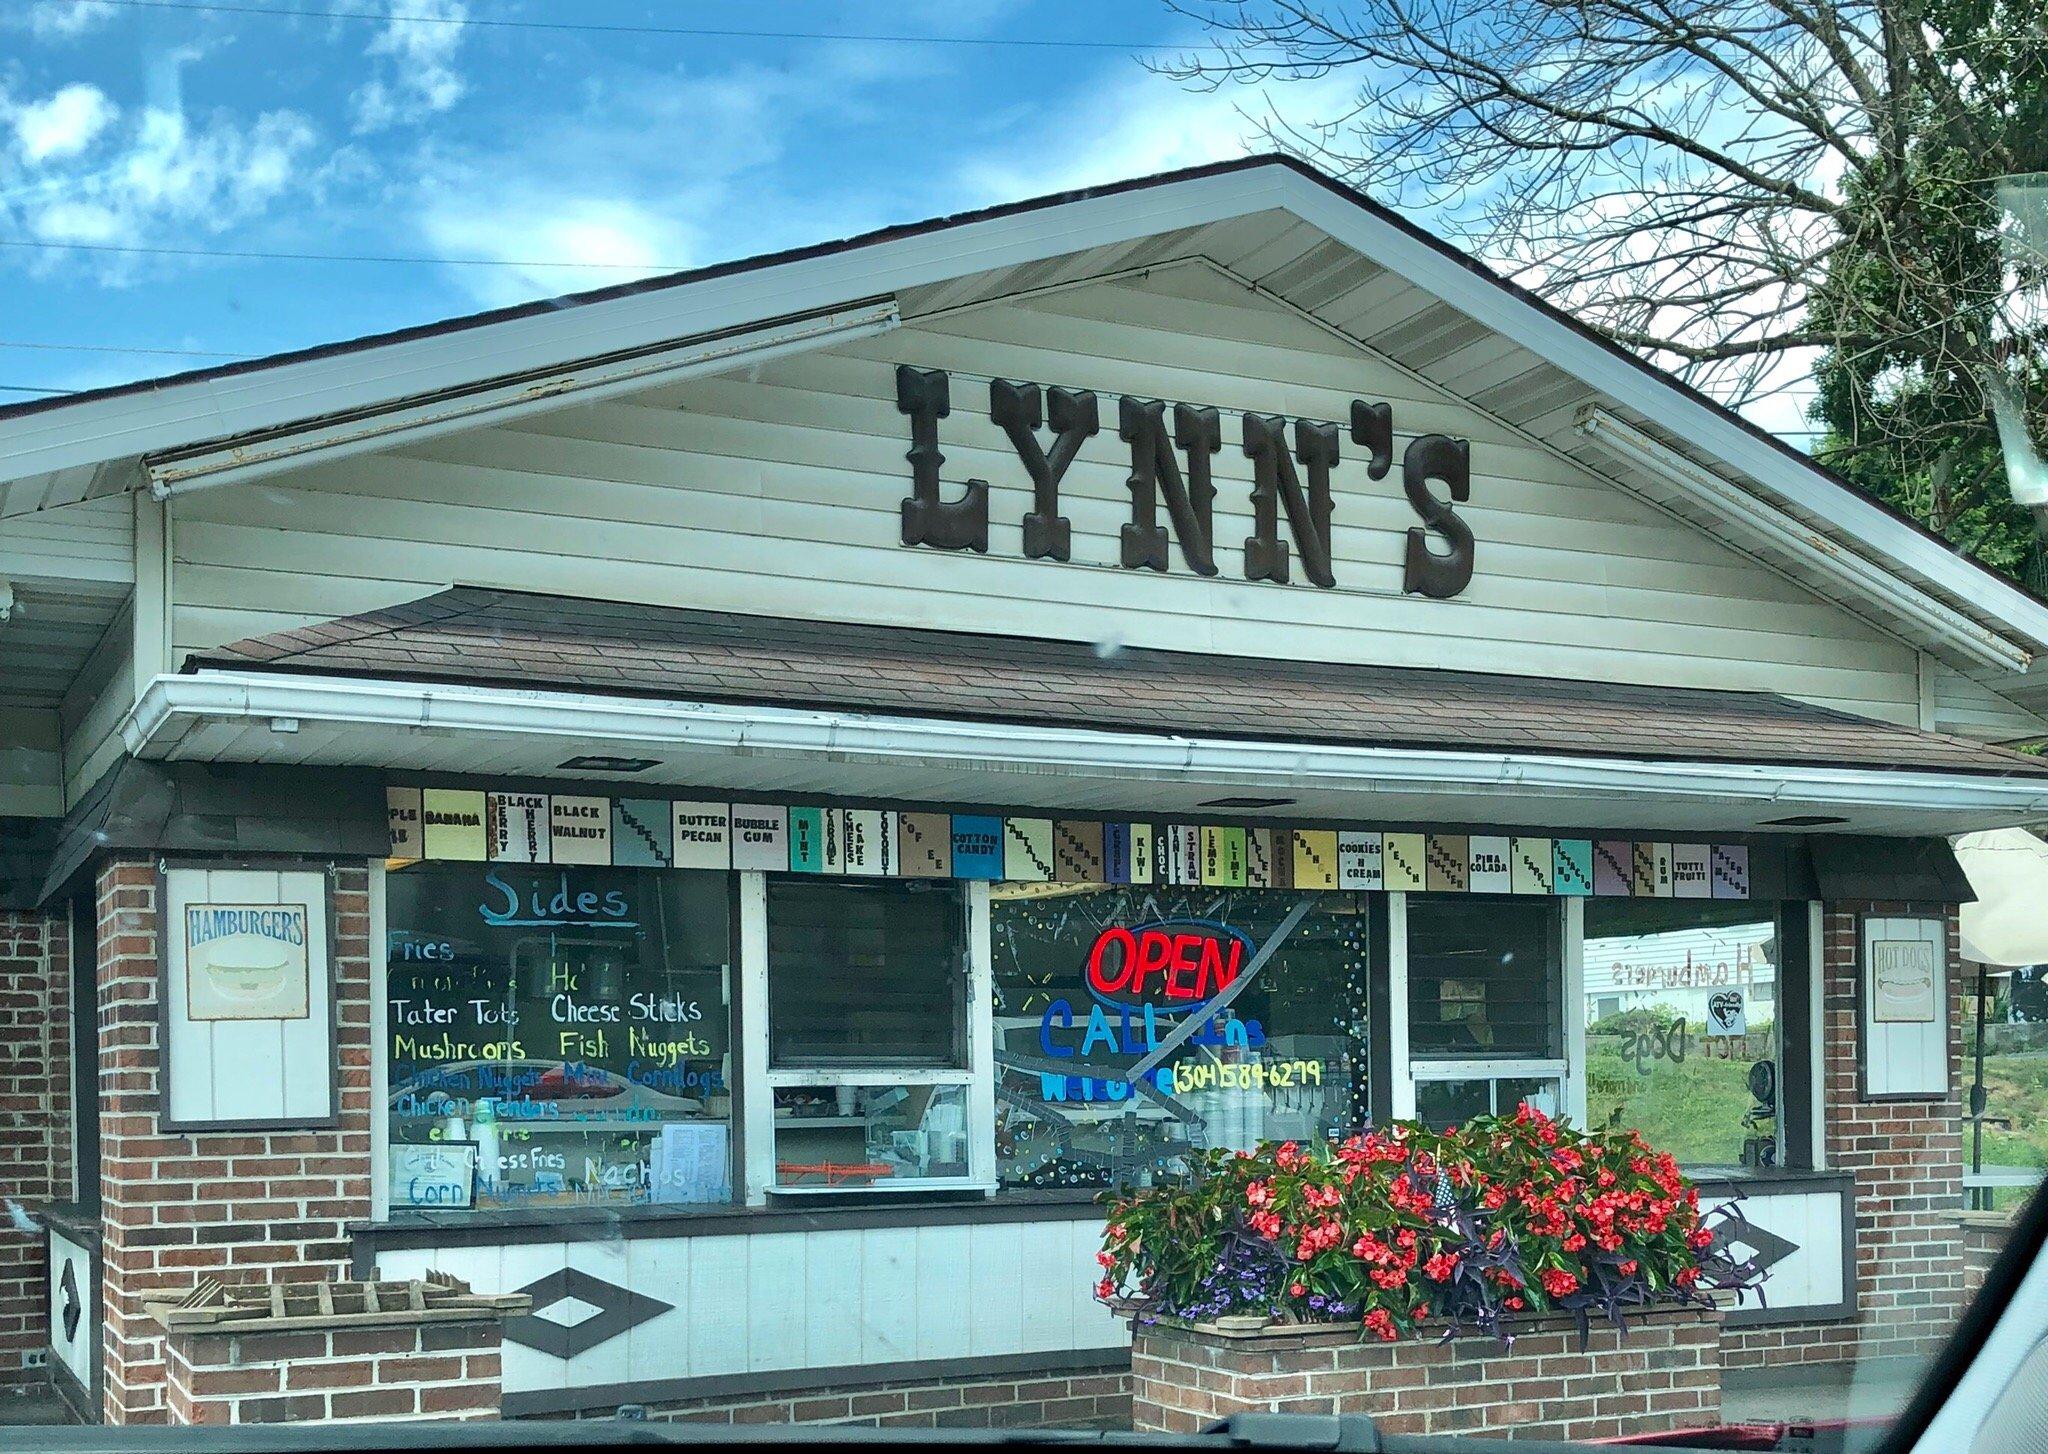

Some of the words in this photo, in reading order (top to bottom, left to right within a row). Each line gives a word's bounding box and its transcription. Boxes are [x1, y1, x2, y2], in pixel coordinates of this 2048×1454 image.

[897, 365, 1474, 598] LYNN'S
[498, 795, 543, 809] BLACK
[553, 805, 600, 818] BLACK
[425, 811, 480, 826] BANANA
[553, 825, 606, 839] WALNUT
[679, 815, 727, 827] BUTTER
[734, 818, 779, 830] BUBBLE
[681, 830, 721, 842] PECAN
[743, 831, 773, 843] GUM
[798, 819, 809, 862] MINT
[855, 823, 864, 866] CAKE
[881, 810, 889, 875] COCONUT
[953, 833, 998, 845] COTTON
[957, 844, 995, 855] CANDY
[1005, 817, 1056, 881] CANTALOPE
[1056, 820, 1098, 866] GERMAN
[1340, 841, 1381, 854] COOKIES
[1137, 837, 1146, 876] KIWI
[1207, 829, 1217, 876] LEMON
[1230, 841, 1240, 880] LIME
[1388, 841, 1419, 883] PEACH
[1428, 835, 1463, 872] PEANUT
[1713, 846, 1743, 875] WATER
[1248, 866, 1267, 887] NUT
[1347, 868, 1381, 879] CREAM
[1428, 854, 1463, 889] BUTTER
[1470, 863, 1507, 873] COLADA
[1660, 857, 1668, 884] RUM
[1676, 862, 1704, 872] TUTTI
[1715, 867, 1747, 894] MELON
[479, 872, 628, 920] Sides
[189, 909, 303, 947] HAMBURGERS
[387, 930, 455, 962] Fries
[1878, 946, 1899, 974] HOT
[1902, 946, 1931, 973] DOGS
[1087, 927, 1243, 999] OPEN
[390, 999, 457, 1025] Tater
[468, 999, 520, 1025] Tots
[552, 994, 621, 1023] Cheese
[629, 992, 702, 1022] Sticks
[1040, 999, 1166, 1057] CALL
[559, 1031, 609, 1059] Fish
[629, 1026, 710, 1068] Nuggets
[1173, 1059, 1321, 1094] (304)589-6279
[397, 1093, 471, 1117] Chicken
[464, 1147, 527, 1172] Chese
[531, 1147, 566, 1169] Fries
[585, 1156, 686, 1186] Nachos
[410, 1177, 463, 1204] Corn
